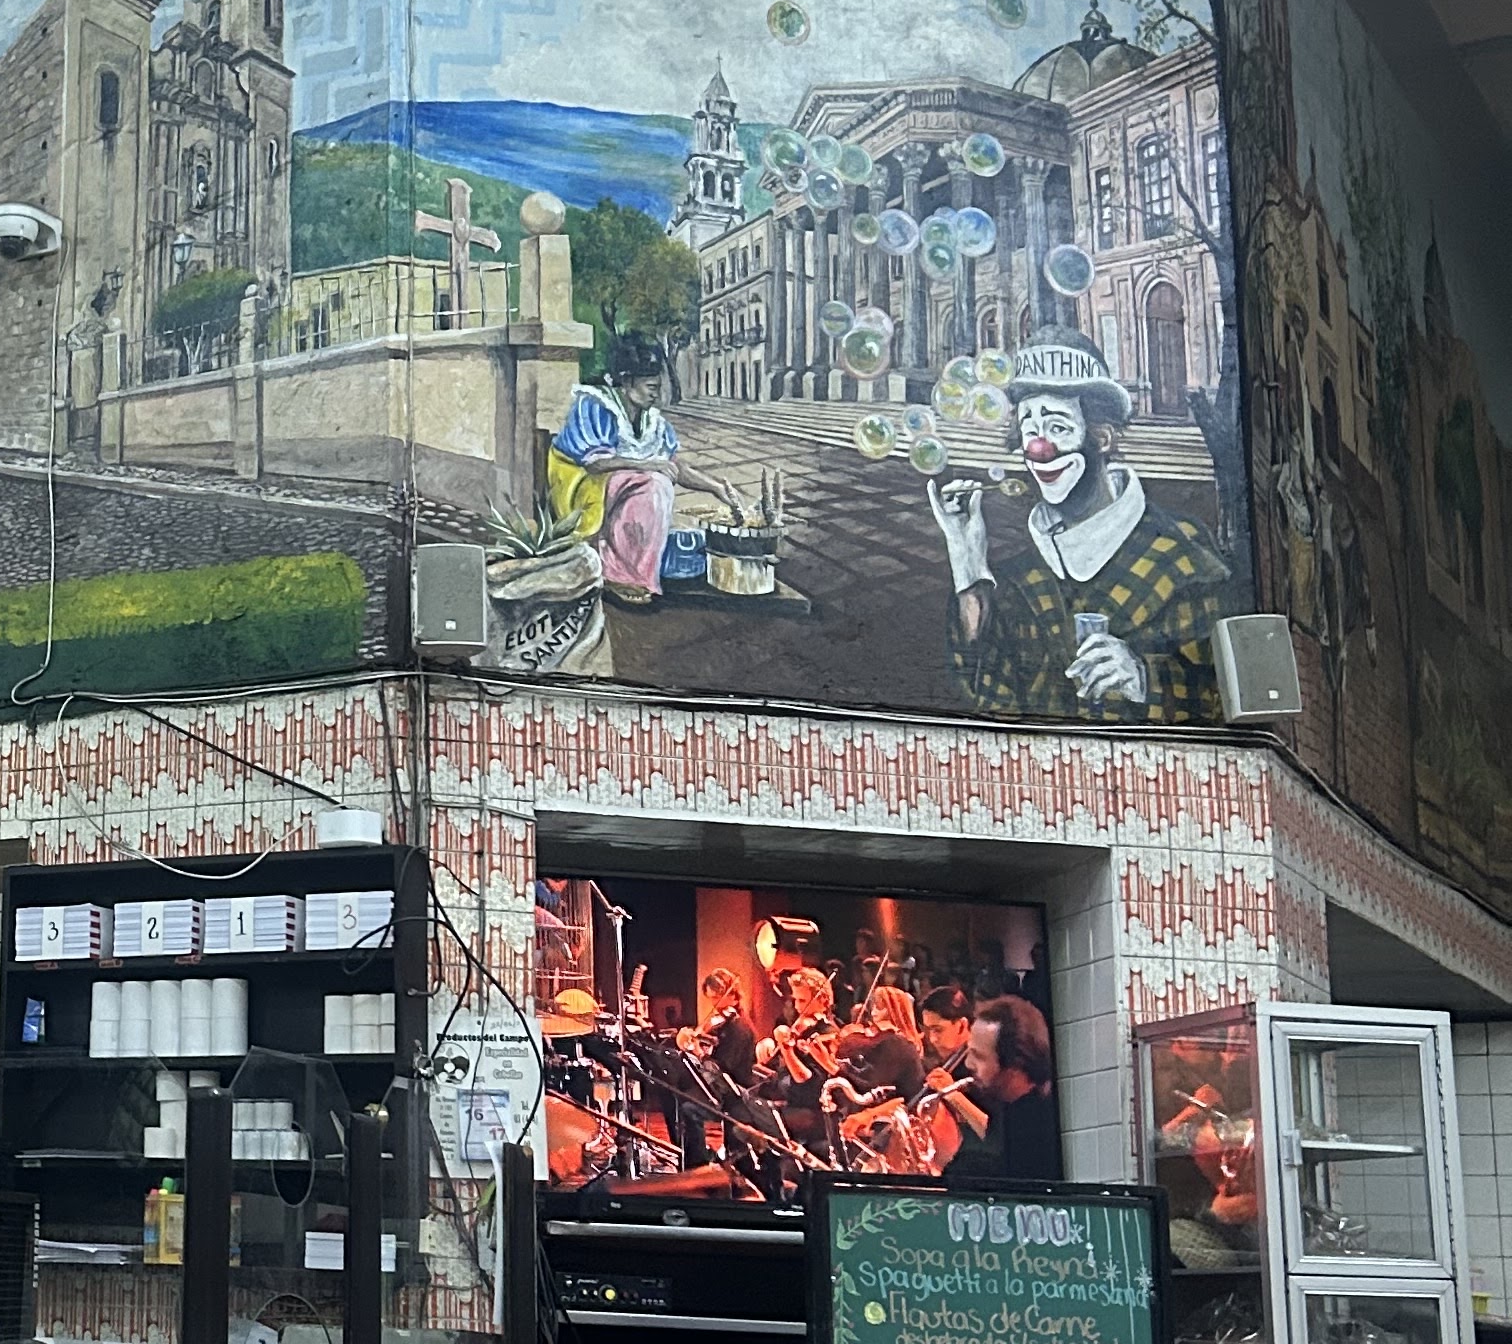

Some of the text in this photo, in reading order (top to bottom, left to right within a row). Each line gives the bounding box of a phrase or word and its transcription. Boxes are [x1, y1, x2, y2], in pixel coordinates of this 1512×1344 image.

[147, 917, 159, 940] 2
[235, 911, 246, 936] 1
[342, 904, 357, 930] 3
[48, 921, 59, 941] 3
[436, 1032, 530, 1044] Productos del Campo
[947, 1203, 1070, 1247] MENU
[881, 1236, 945, 1277] Sopa
[859, 1261, 981, 1301] Spaguetti
[889, 1291, 1101, 1341] Flautas de Carne
